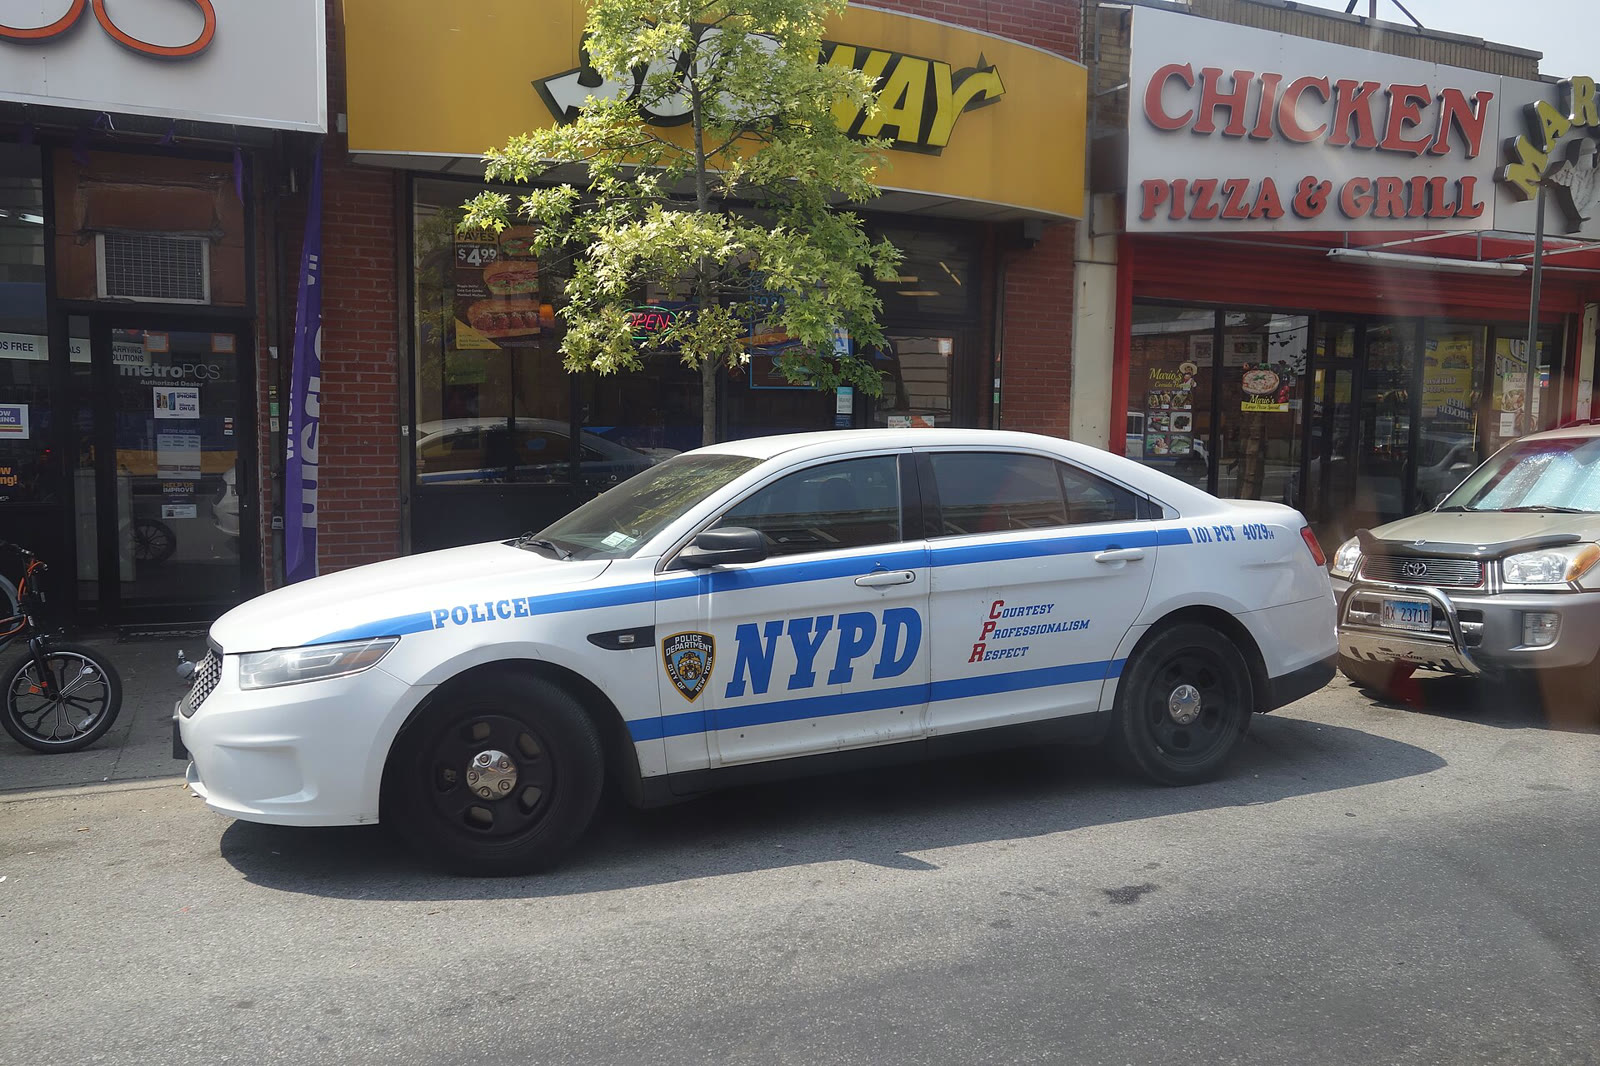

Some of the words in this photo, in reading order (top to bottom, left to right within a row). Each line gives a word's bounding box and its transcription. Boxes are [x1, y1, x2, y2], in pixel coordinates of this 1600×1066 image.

[1143, 62, 1494, 159] CHICKEN
[1140, 177, 1285, 220] PIZZA
[1293, 175, 1333, 219] &
[1339, 176, 1485, 219] GRILL
[11, 342, 34, 351] FREE
[120, 363, 221, 381] metroPCS
[1149, 368, 1183, 380] Mario's
[140, 379, 180, 387] Authorized
[1249, 394, 1275, 404] Mario's
[1192, 525, 1212, 543] 101
[1214, 524, 1235, 542] PCT
[433, 597, 529, 629] POLICE
[1385, 606, 1396, 620] AX
[674, 635, 703, 644] POLICE
[665, 641, 712, 657] DEPARTMENT
[724, 607, 922, 699] NYPD
[667, 663, 679, 681] CITY
[676, 681, 686, 690] OF
[695, 679, 706, 692] NEW
[703, 656, 713, 676] YORK
